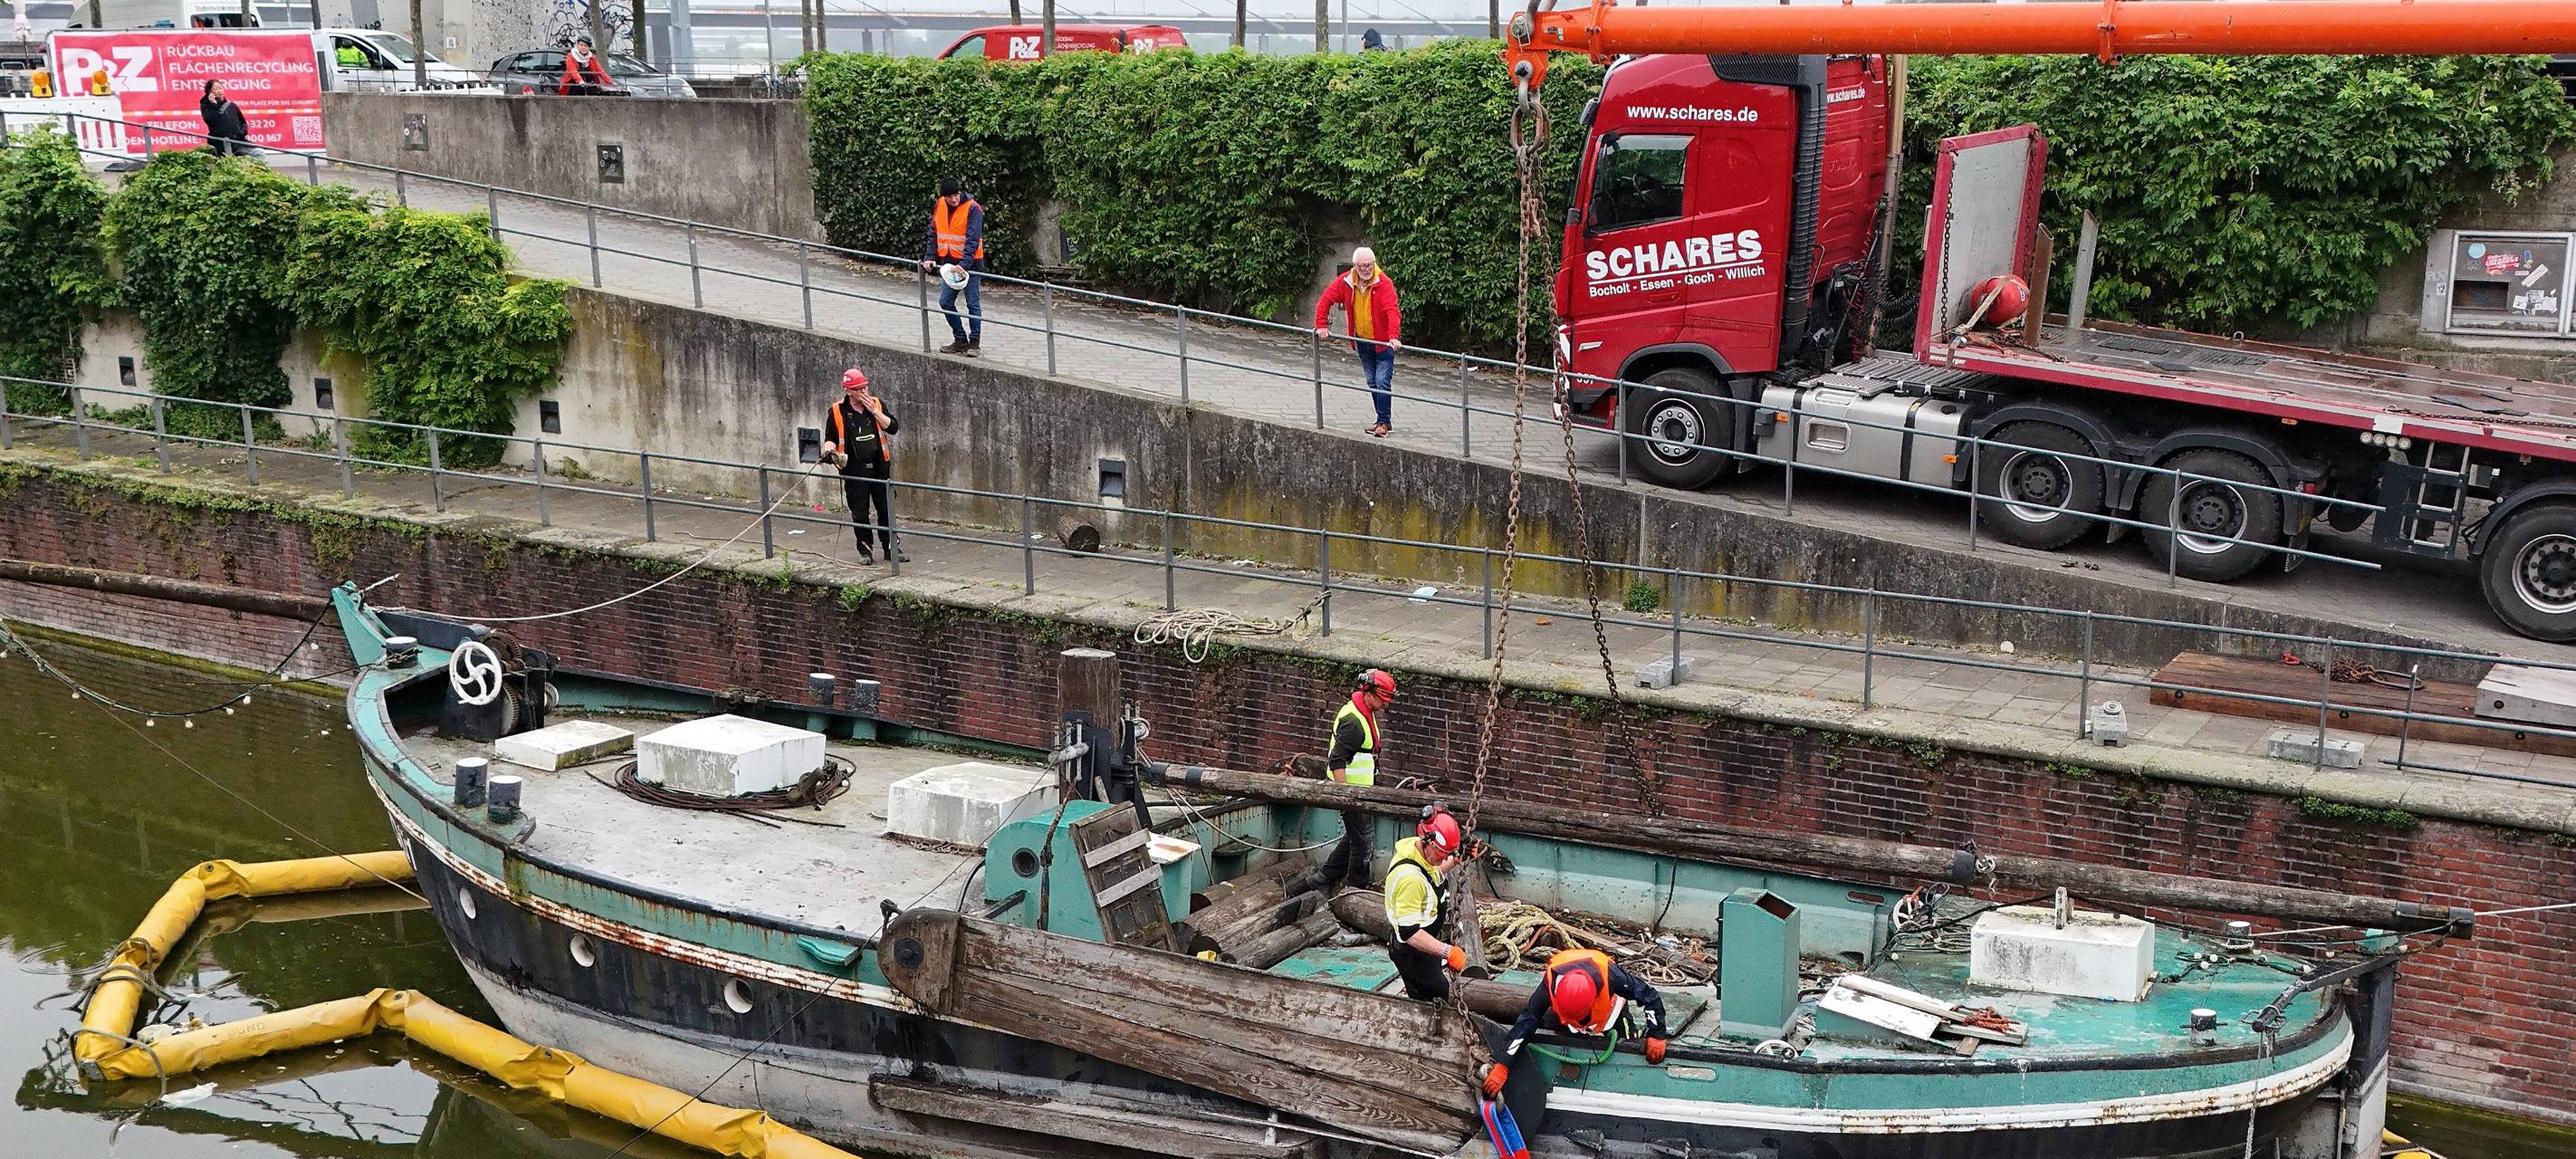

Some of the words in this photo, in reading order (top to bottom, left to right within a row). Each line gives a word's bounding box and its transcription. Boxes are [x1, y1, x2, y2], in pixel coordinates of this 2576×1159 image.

[167, 43, 235, 57] RÜCKBAU
[1010, 36, 1041, 59] P&Z
[169, 60, 314, 73] FLÄCHENRECYCLING
[171, 79, 271, 91] ENTSRGUNG
[1627, 104, 1758, 122] www.schares.de
[150, 135, 202, 145] HOTLINE:
[1586, 229, 1762, 280] SCHARES
[1589, 282, 1631, 297] Bocholt
[1640, 277, 1674, 292] Essen
[1685, 272, 1714, 286] Goch
[1726, 265, 1765, 280] Willich
